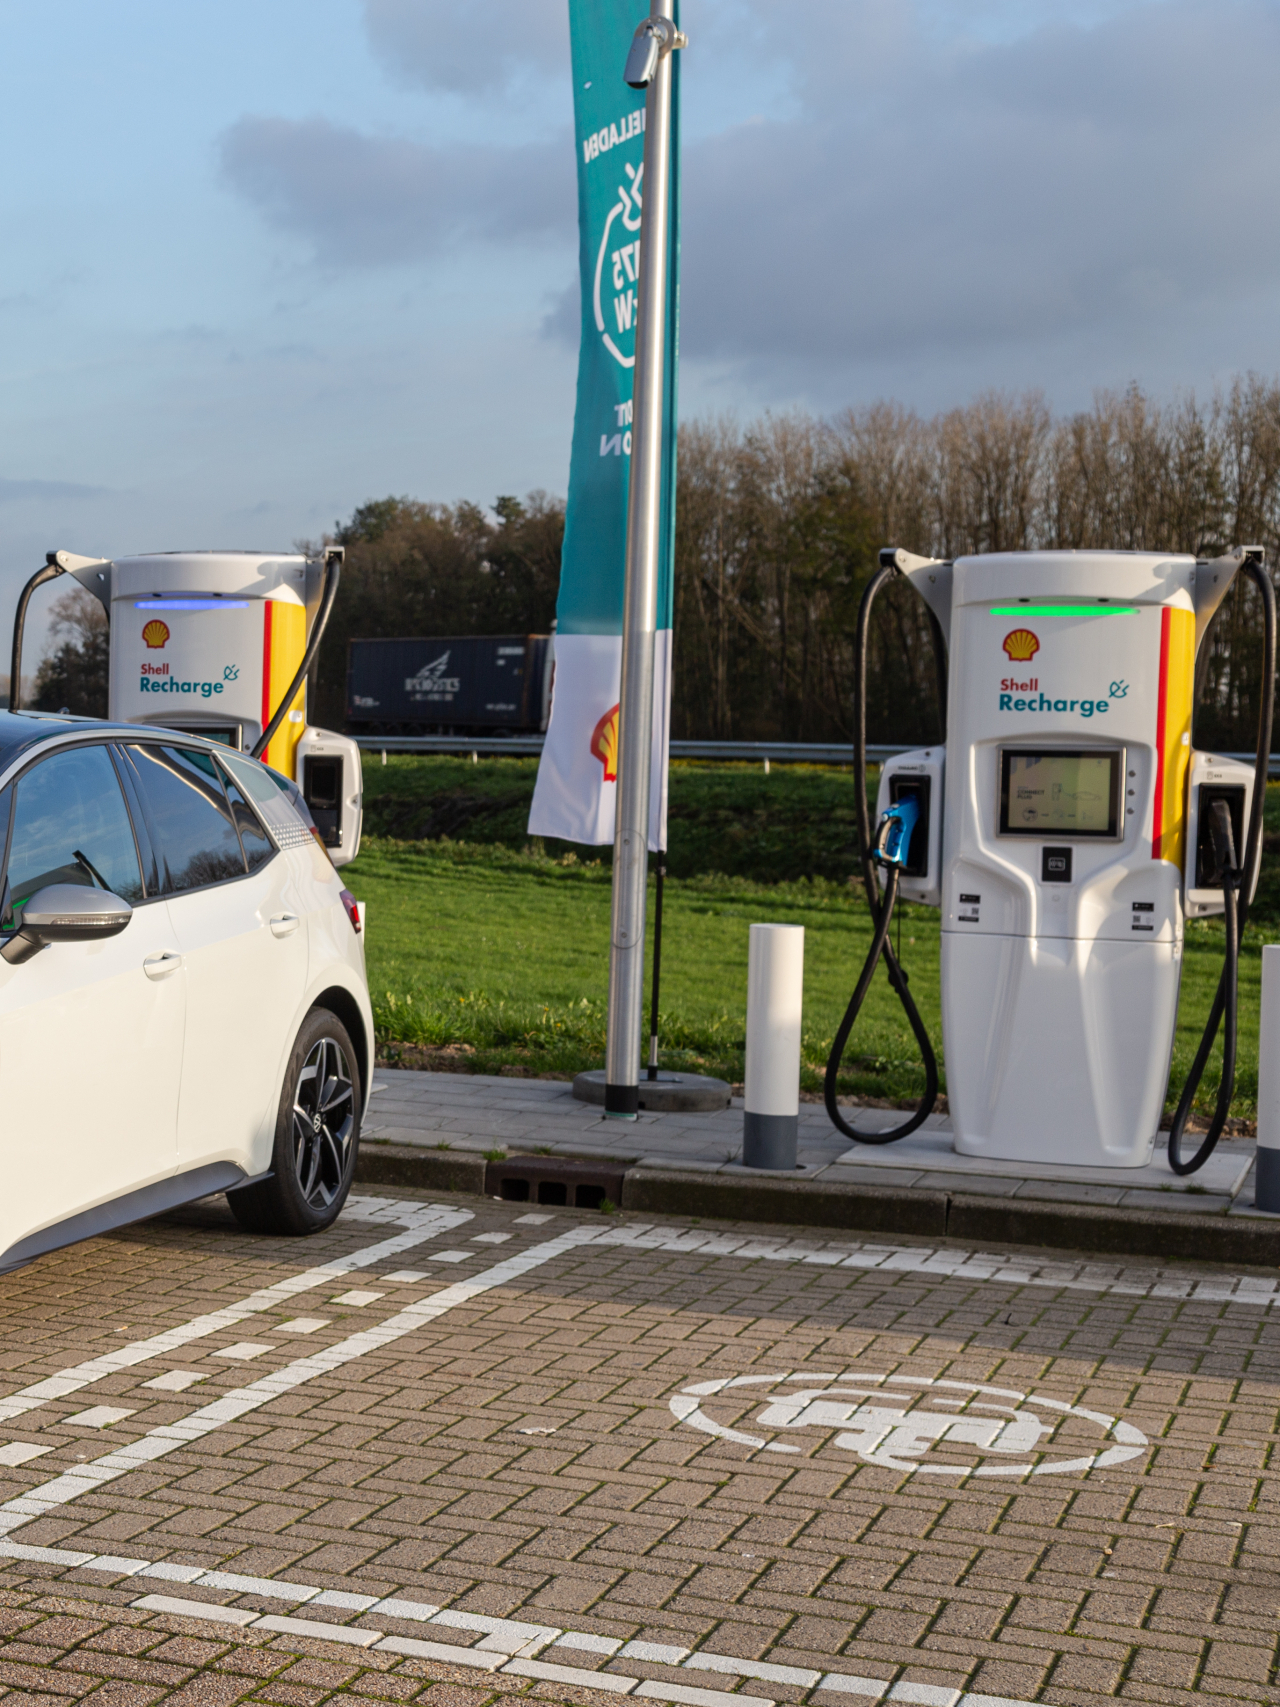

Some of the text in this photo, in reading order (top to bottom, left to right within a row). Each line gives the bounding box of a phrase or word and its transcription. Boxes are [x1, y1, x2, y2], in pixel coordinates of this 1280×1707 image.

[141, 663, 169, 675] Shell
[140, 676, 224, 698] Recharge
[1000, 678, 1038, 691] Shell
[999, 692, 1109, 718] Recharge
